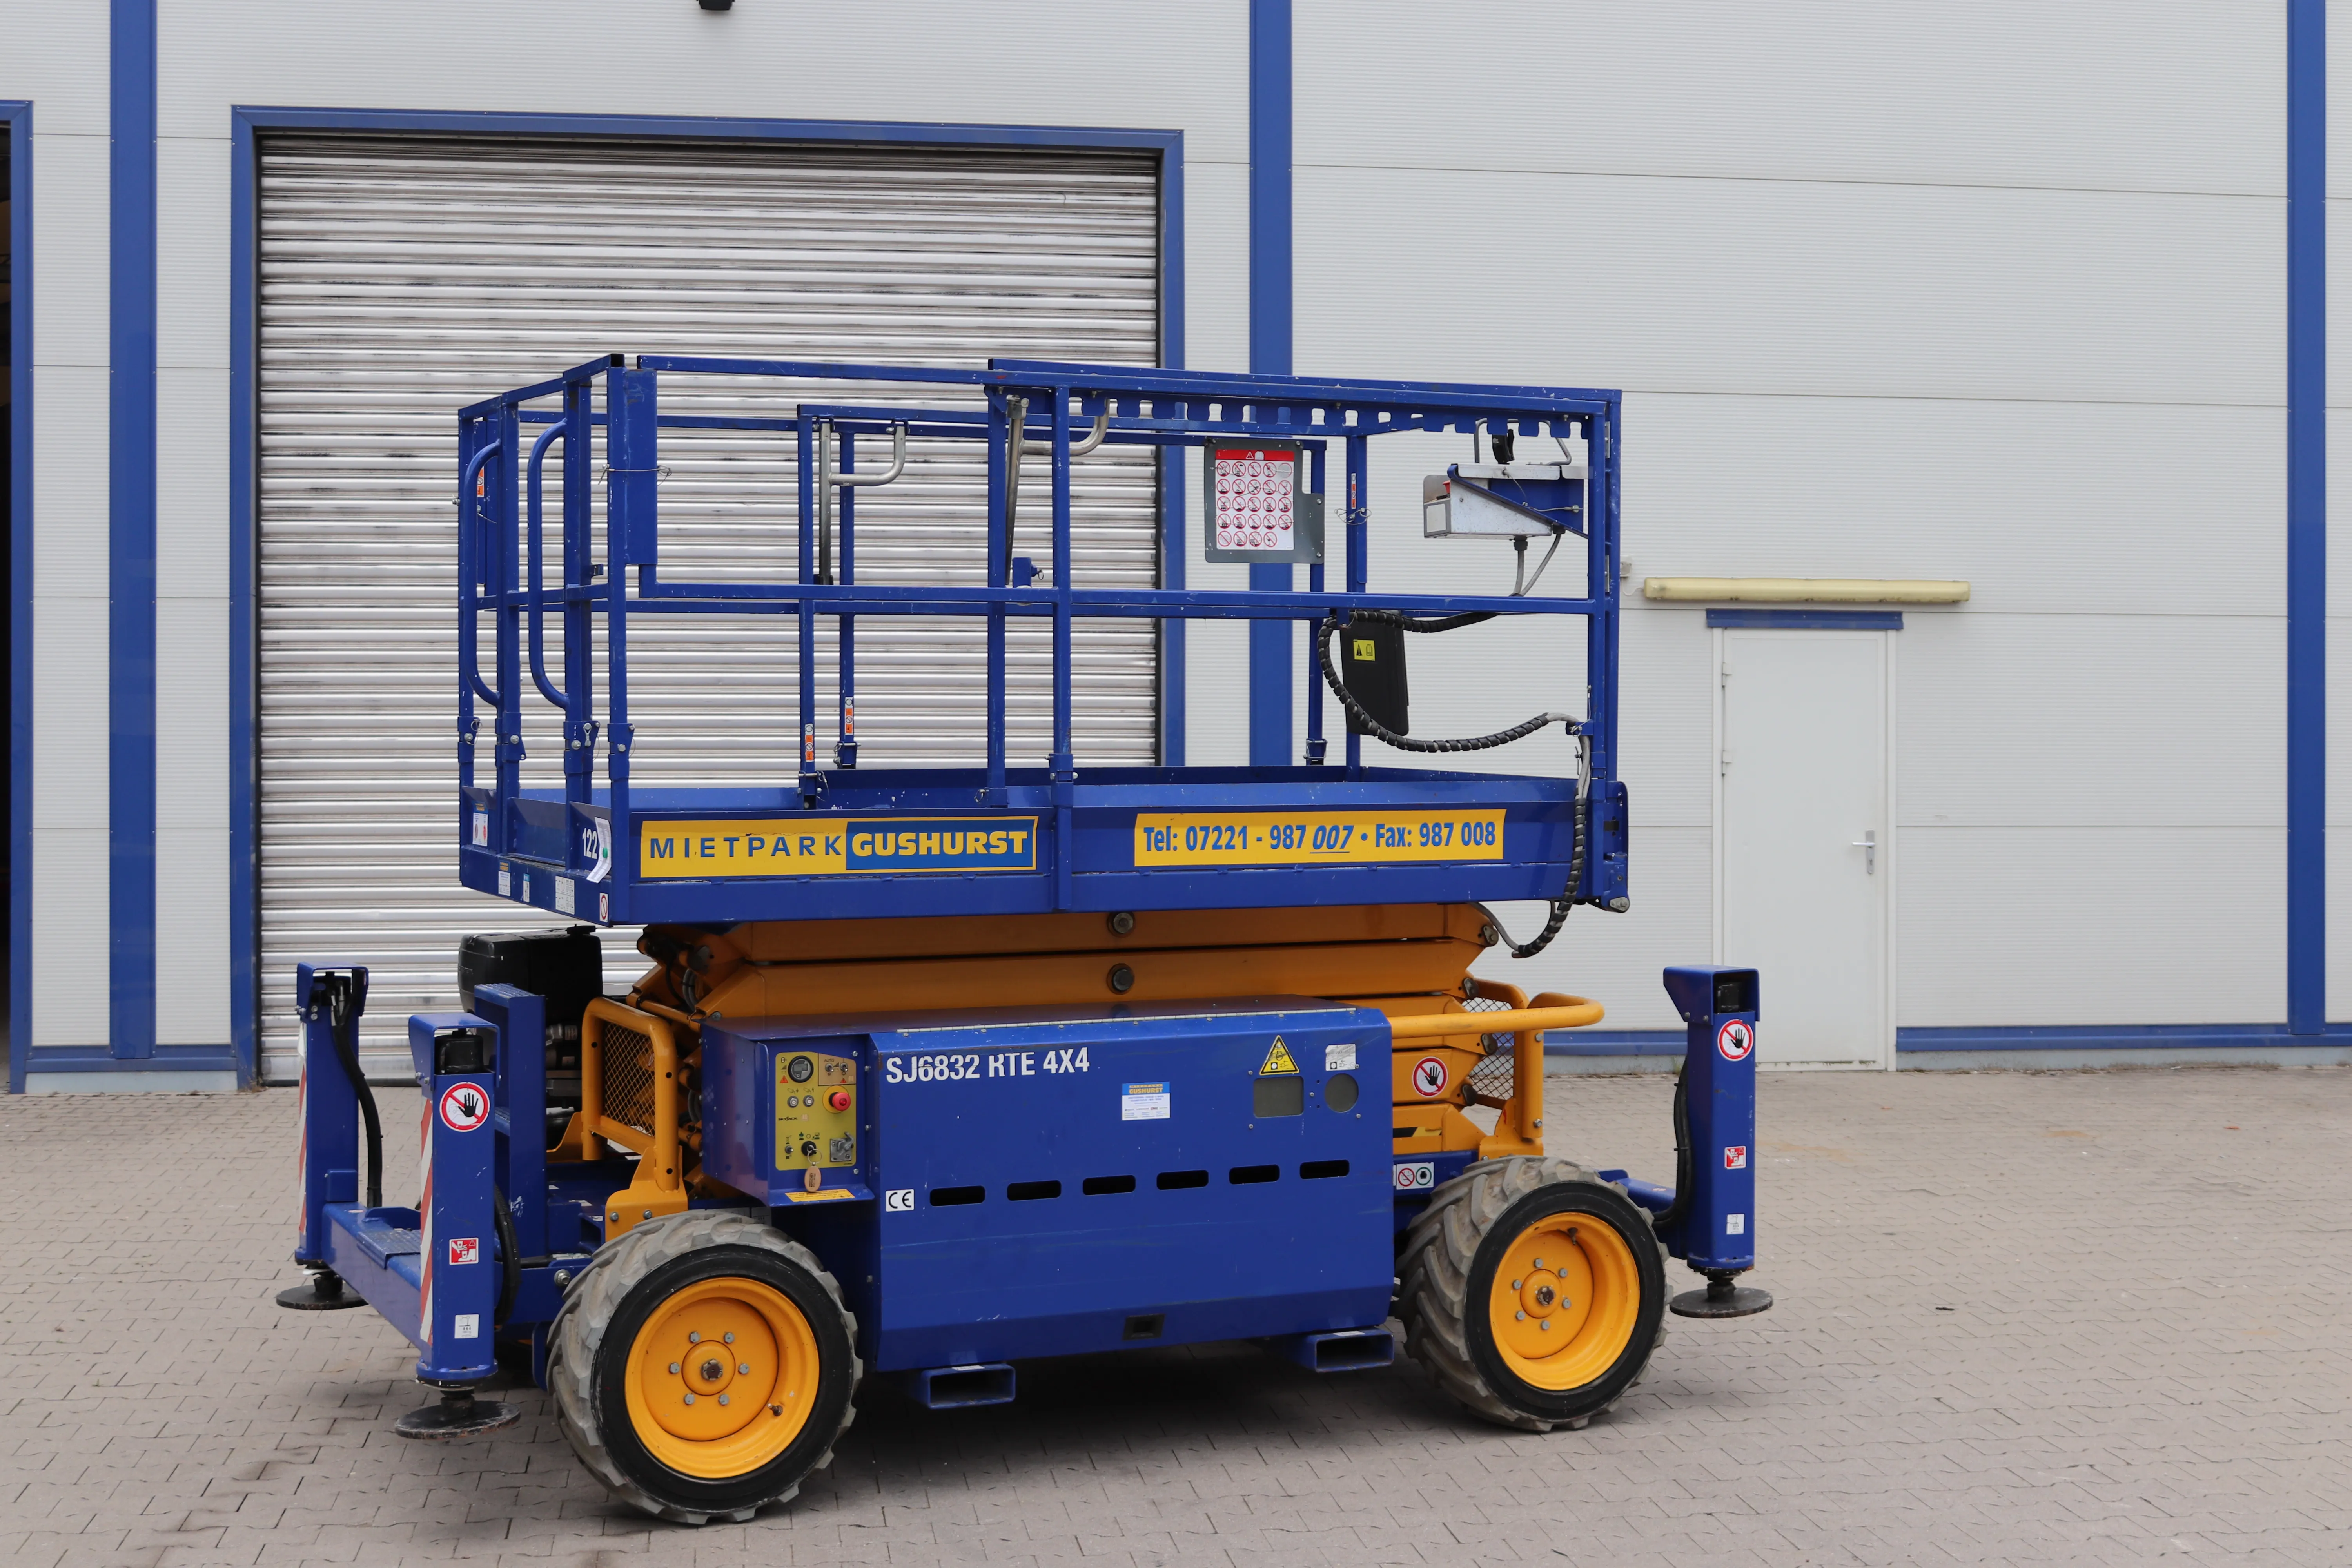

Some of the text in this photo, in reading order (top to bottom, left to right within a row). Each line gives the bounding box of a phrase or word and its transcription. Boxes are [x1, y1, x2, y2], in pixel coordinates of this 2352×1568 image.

[582, 828, 598, 860] 122
[650, 831, 1028, 858] MIETPARK GUSHURST
[1143, 826, 1178, 851] Tel:
[1186, 825, 1248, 851] 07221
[1270, 824, 1306, 849] 987
[1312, 825, 1354, 850] 007
[1376, 823, 1412, 847] Fax:
[1419, 822, 1454, 847] 987
[1461, 822, 1495, 846] 008
[886, 1047, 1090, 1083] SJ6832 RTE 4X4
[888, 1191, 912, 1209] CE
